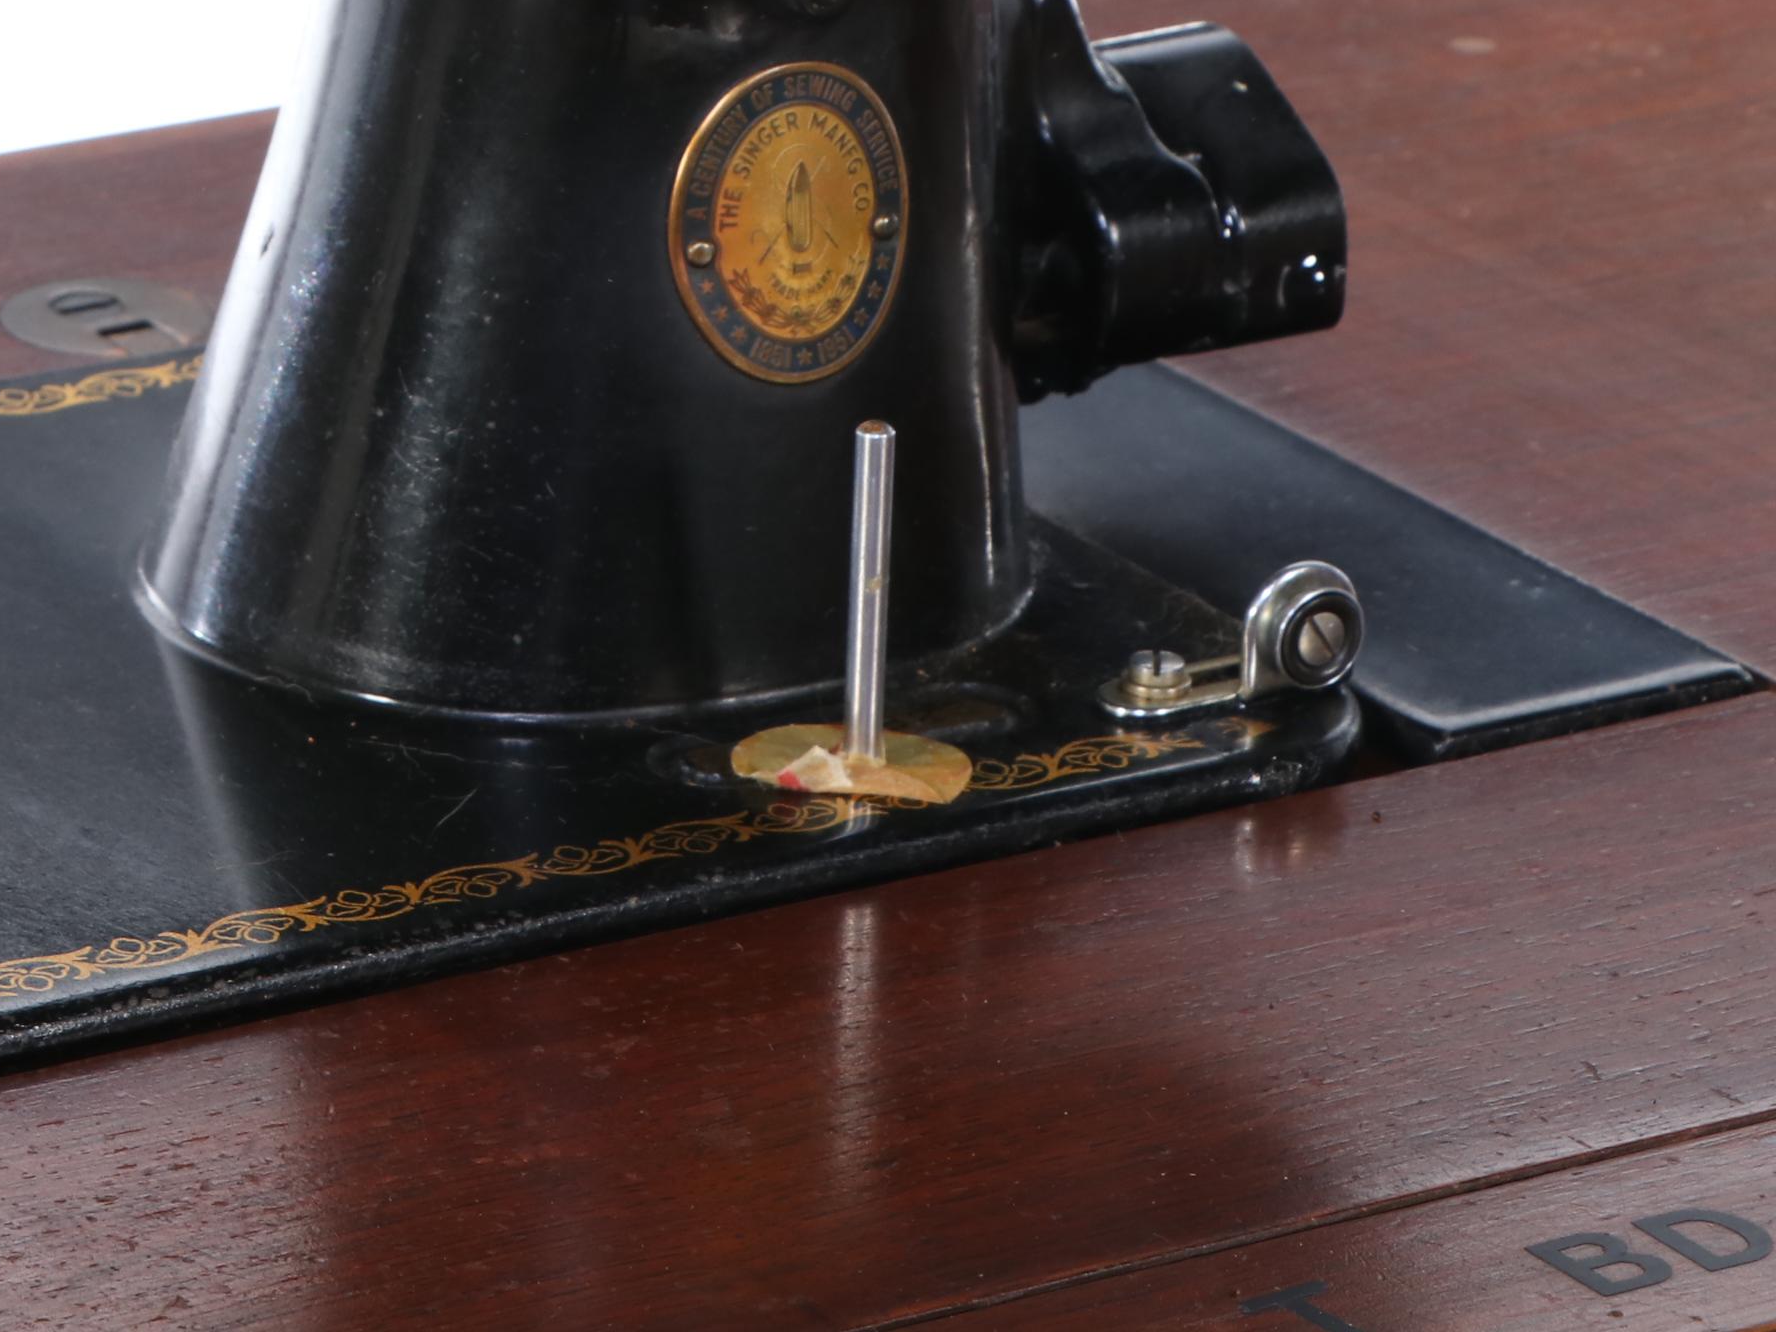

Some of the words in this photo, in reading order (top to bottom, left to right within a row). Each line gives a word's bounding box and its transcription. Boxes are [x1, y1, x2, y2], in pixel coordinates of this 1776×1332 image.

[750, 82, 775, 111] OF
[783, 74, 858, 112] SEWING
[690, 105, 749, 197] CENTURY
[719, 189, 743, 232] THE
[733, 111, 801, 180] SINGER
[856, 109, 898, 193] SERVICE
[687, 206, 707, 220] A
